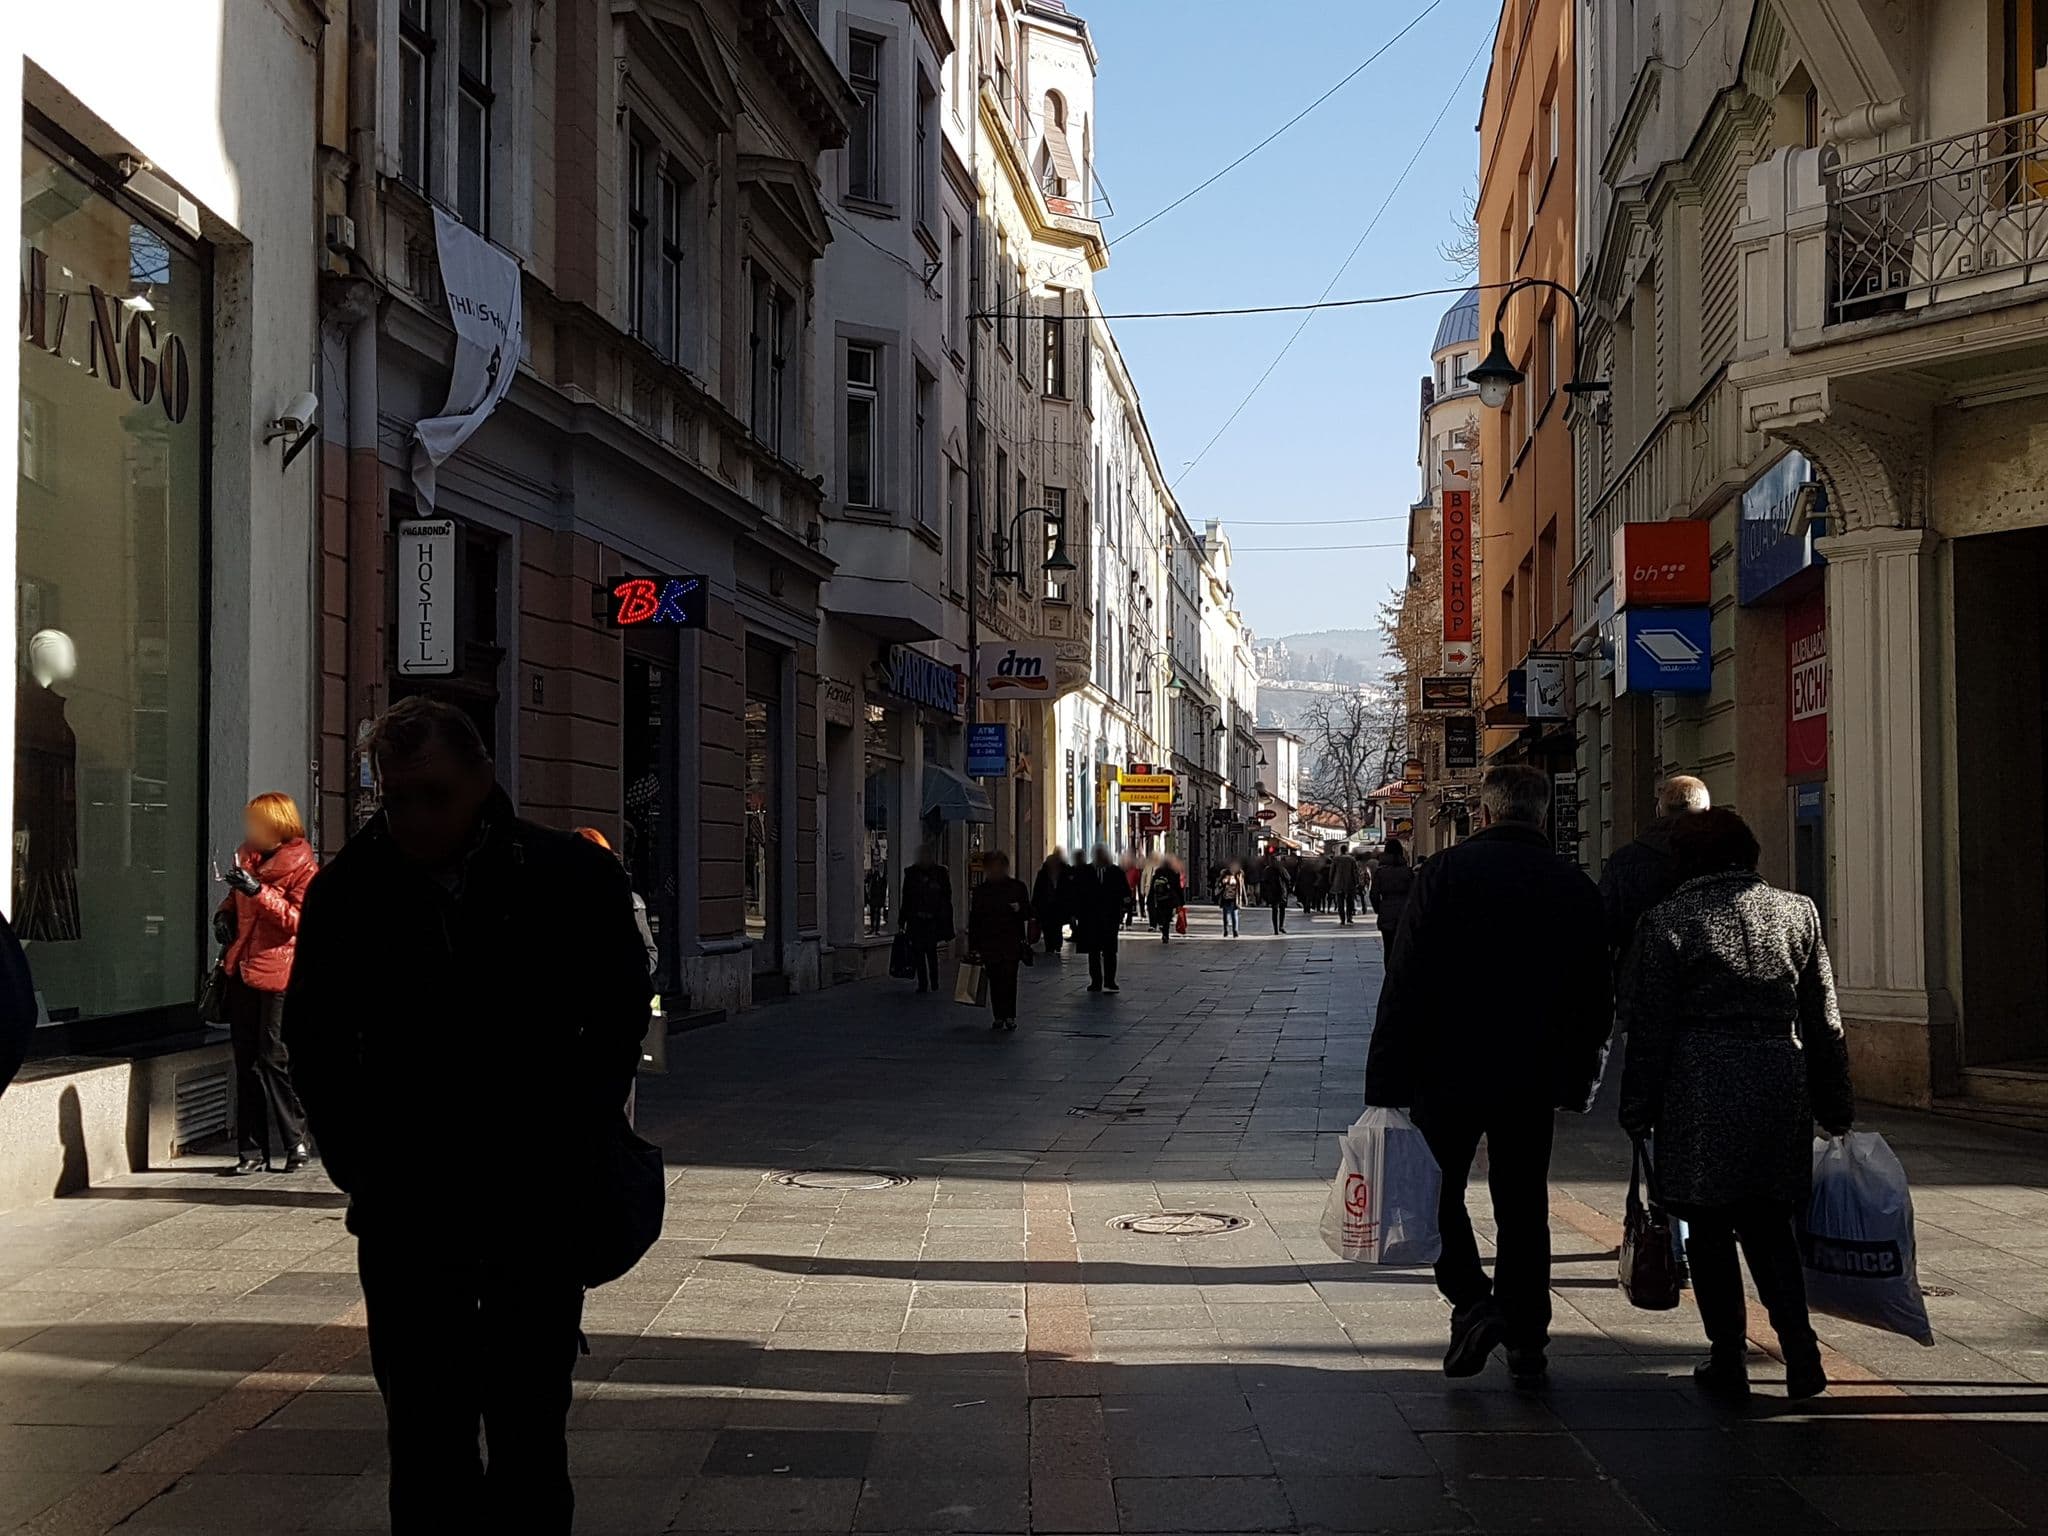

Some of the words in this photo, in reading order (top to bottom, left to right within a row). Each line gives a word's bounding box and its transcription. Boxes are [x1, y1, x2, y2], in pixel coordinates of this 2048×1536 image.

[1449, 493, 1465, 632] BOOKSHOP
[417, 543, 433, 661] HOSTEL
[613, 578, 699, 625] BK
[889, 644, 957, 713] SPARKASSE
[997, 650, 1042, 676] dm
